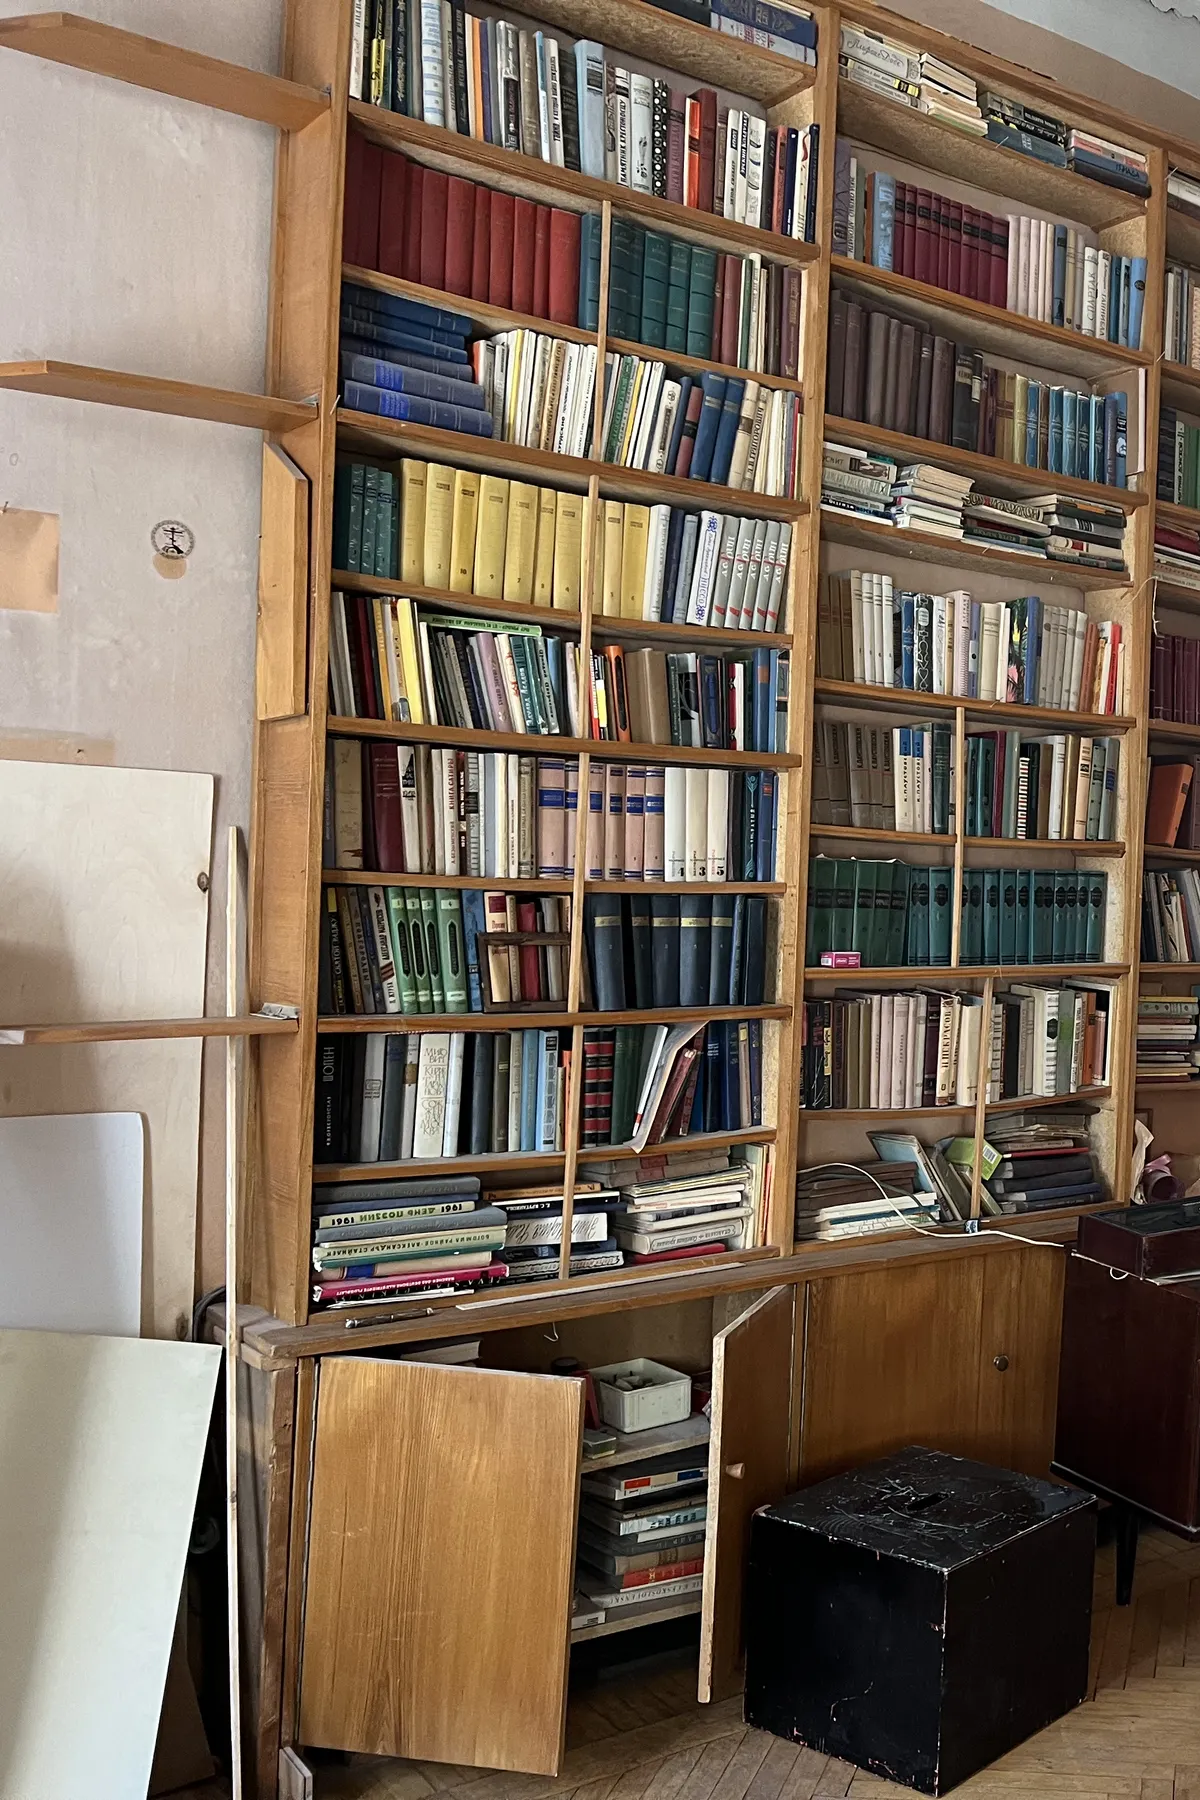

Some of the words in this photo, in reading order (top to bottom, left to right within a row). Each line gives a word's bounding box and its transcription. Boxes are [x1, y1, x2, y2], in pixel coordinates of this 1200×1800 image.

[619, 145, 628, 183] ПАМЯТНИК
[1086, 270, 1096, 321] СПАРТАК
[699, 866, 706, 876] 3
[716, 866, 725, 876] 5
[379, 934, 390, 960] АЛЕКСАНДР
[322, 1047, 335, 1081] ШОПЕН
[408, 1207, 435, 1216] ДЕНЬ
[441, 1203, 462, 1213] 1961
[332, 1216, 354, 1226] 1961
[359, 1210, 403, 1222] ПОЭЗИИ
